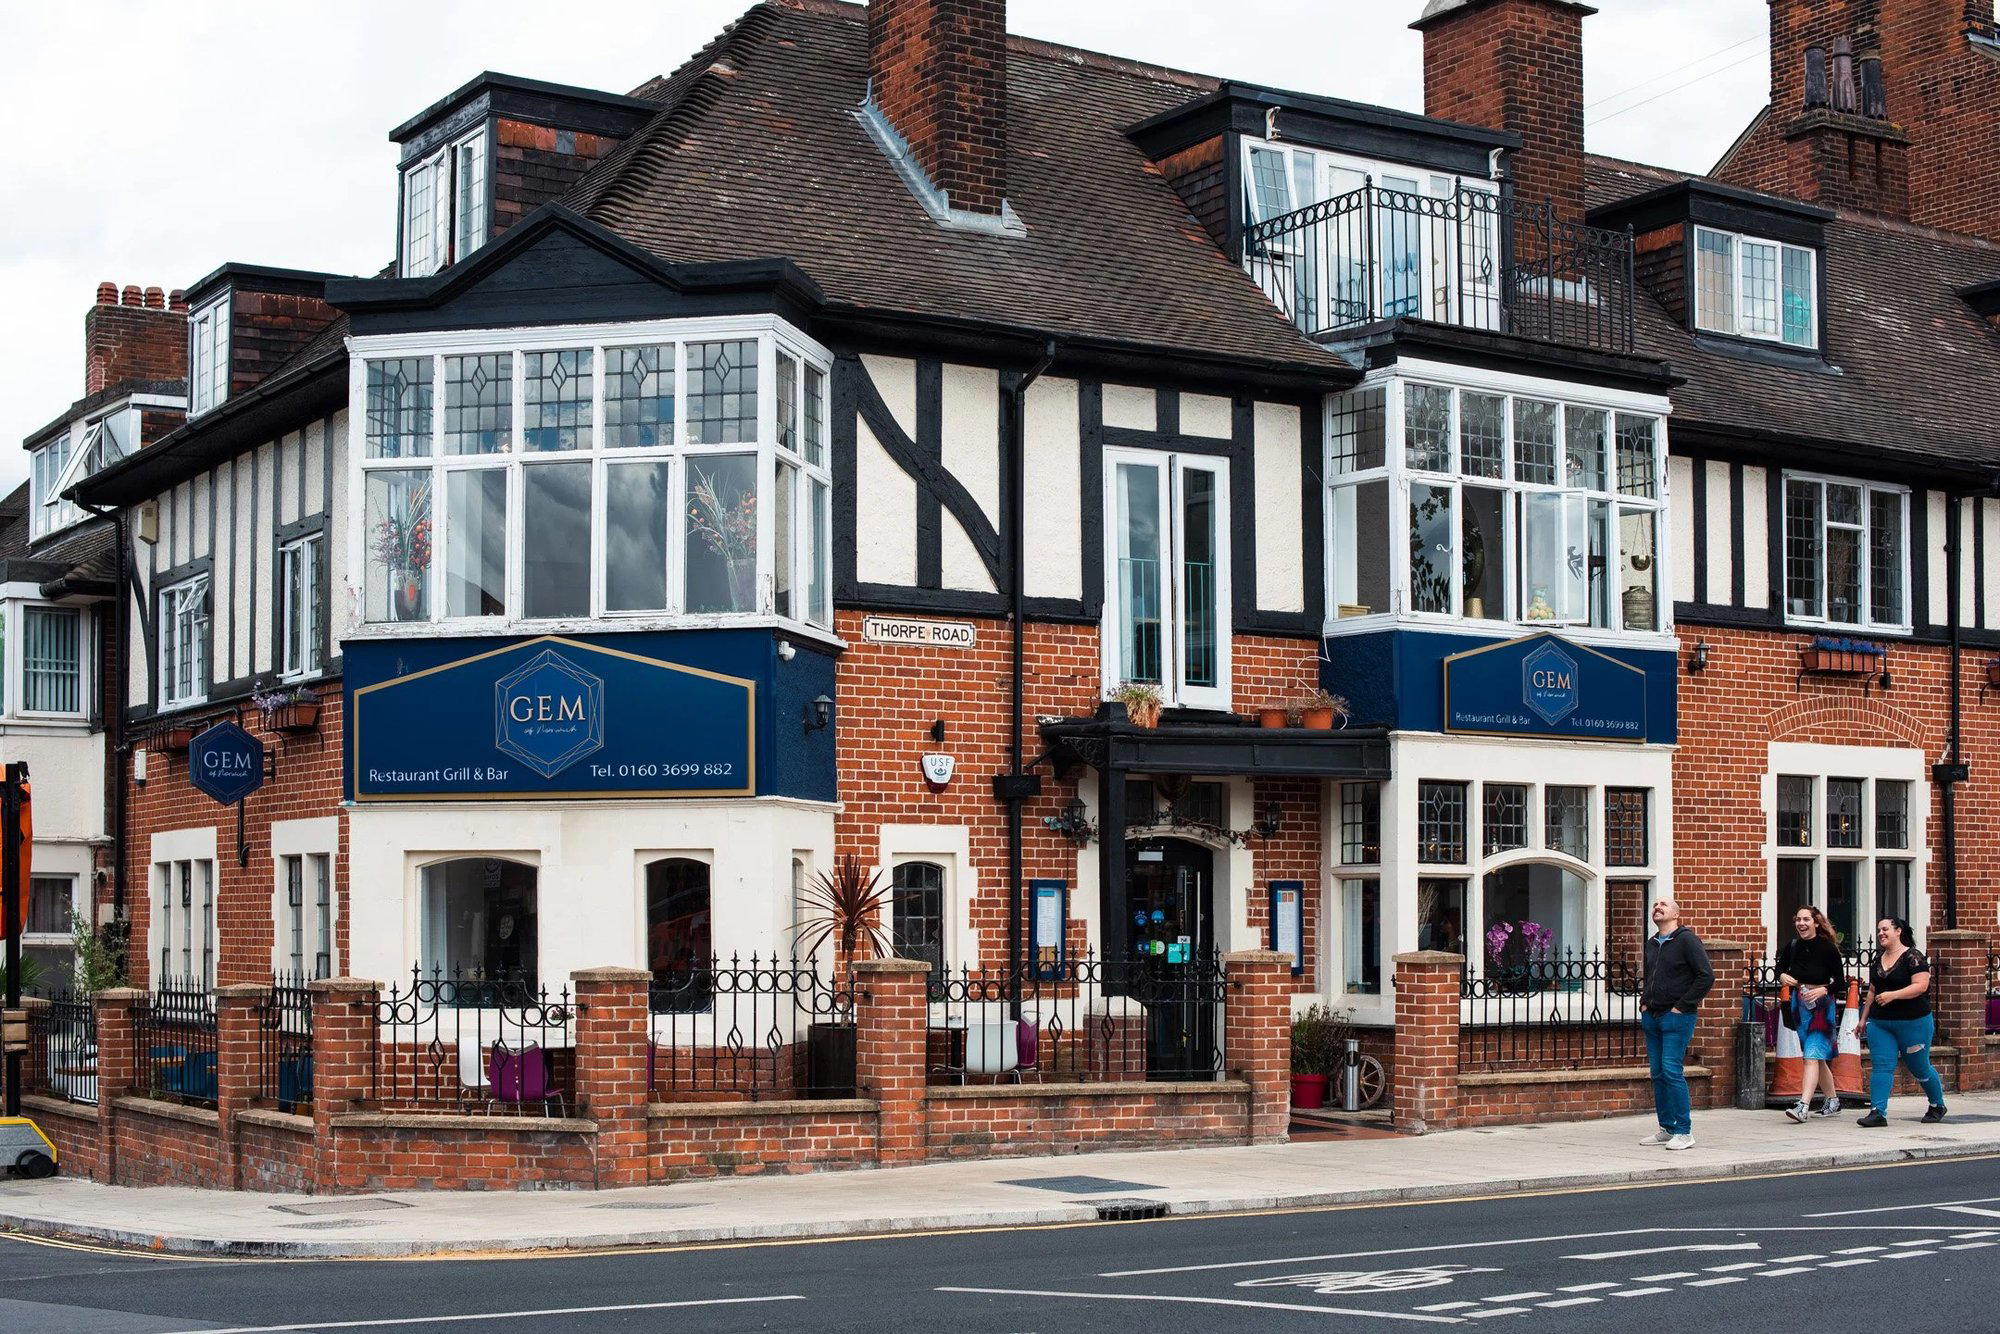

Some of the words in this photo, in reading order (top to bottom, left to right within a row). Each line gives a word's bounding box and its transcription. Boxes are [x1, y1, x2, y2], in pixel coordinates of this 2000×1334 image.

[871, 622, 926, 639] THORPE
[1533, 670, 1572, 689] GEM
[510, 695, 586, 722] GEM
[1456, 712, 1495, 723] Restaurant
[1496, 714, 1511, 724] Grill
[1512, 715, 1518, 724] &
[1519, 715, 1531, 725] Bar
[1585, 718, 1604, 728] 0160
[1625, 721, 1639, 730] 882
[204, 750, 252, 768] GEM
[369, 768, 440, 782] Restaurant
[443, 767, 470, 781] Grill
[473, 767, 484, 781] &
[487, 767, 509, 781] Bar
[590, 764, 615, 777] Tel.
[618, 764, 657, 777] 0160
[661, 763, 700, 776] 3699
[703, 763, 732, 775] 882
